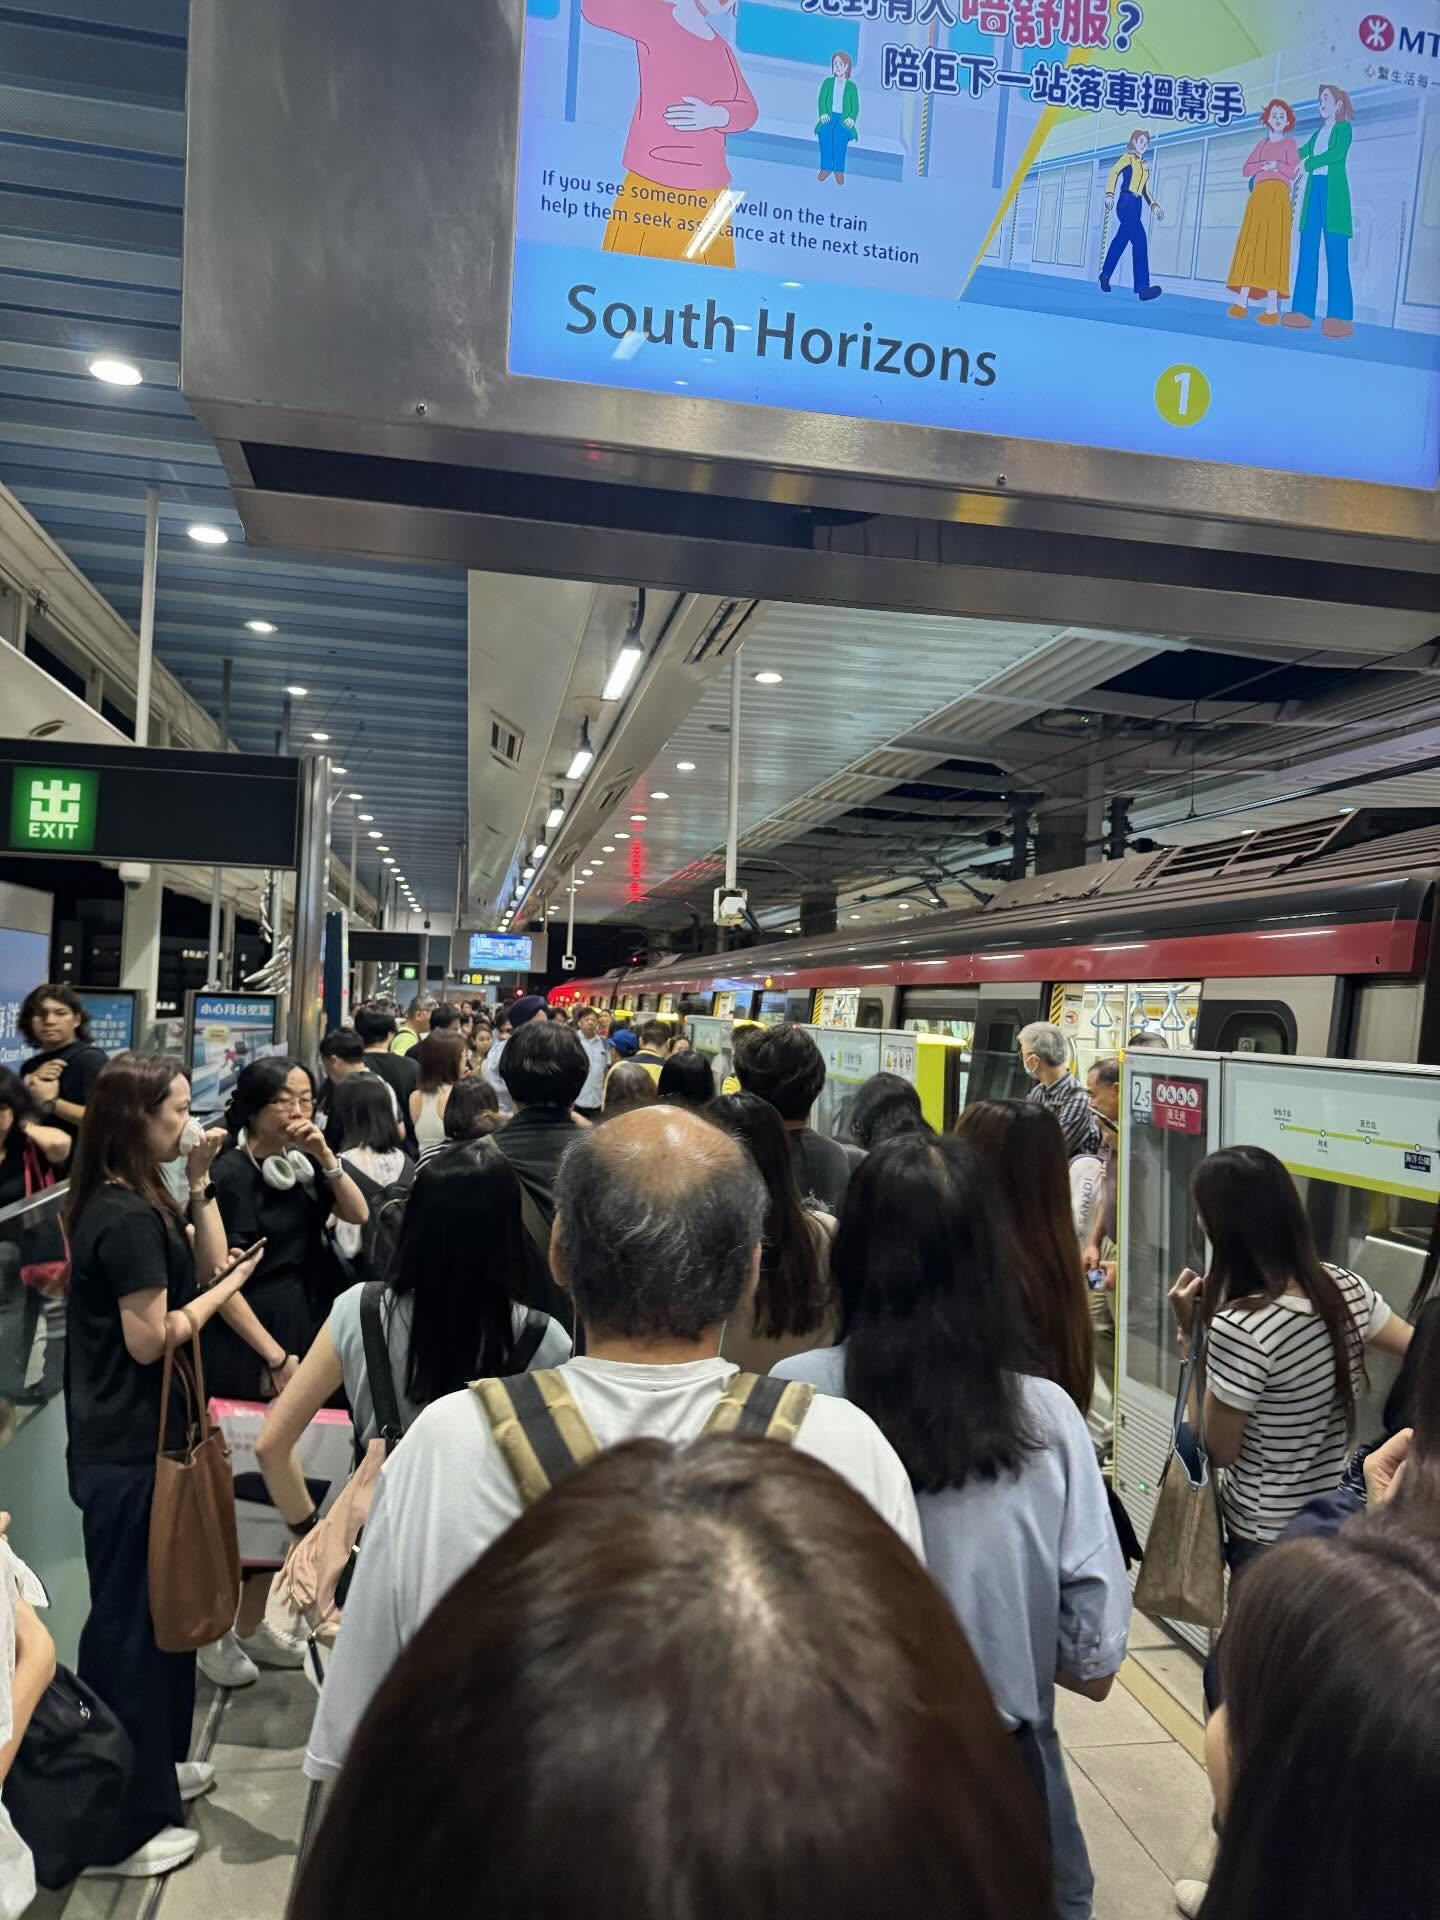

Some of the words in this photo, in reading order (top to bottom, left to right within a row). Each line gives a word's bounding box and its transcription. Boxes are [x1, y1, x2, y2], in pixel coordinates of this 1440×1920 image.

[541, 195, 578, 218] help
[584, 202, 628, 221] them
[634, 211, 672, 228] seek
[769, 230, 786, 245] at
[791, 231, 817, 249] the
[822, 238, 858, 255] next
[863, 243, 919, 264] station
[542, 169, 555, 186] If
[559, 175, 591, 192] you
[596, 181, 625, 196] see
[631, 186, 708, 208] someone
[713, 198, 768, 218] well
[773, 206, 793, 221] on
[798, 208, 825, 225] the
[830, 212, 868, 232] train
[565, 284, 736, 352] South
[756, 308, 997, 386] Horizons
[1174, 372, 1191, 414] 1
[28, 821, 79, 839] EXIT
